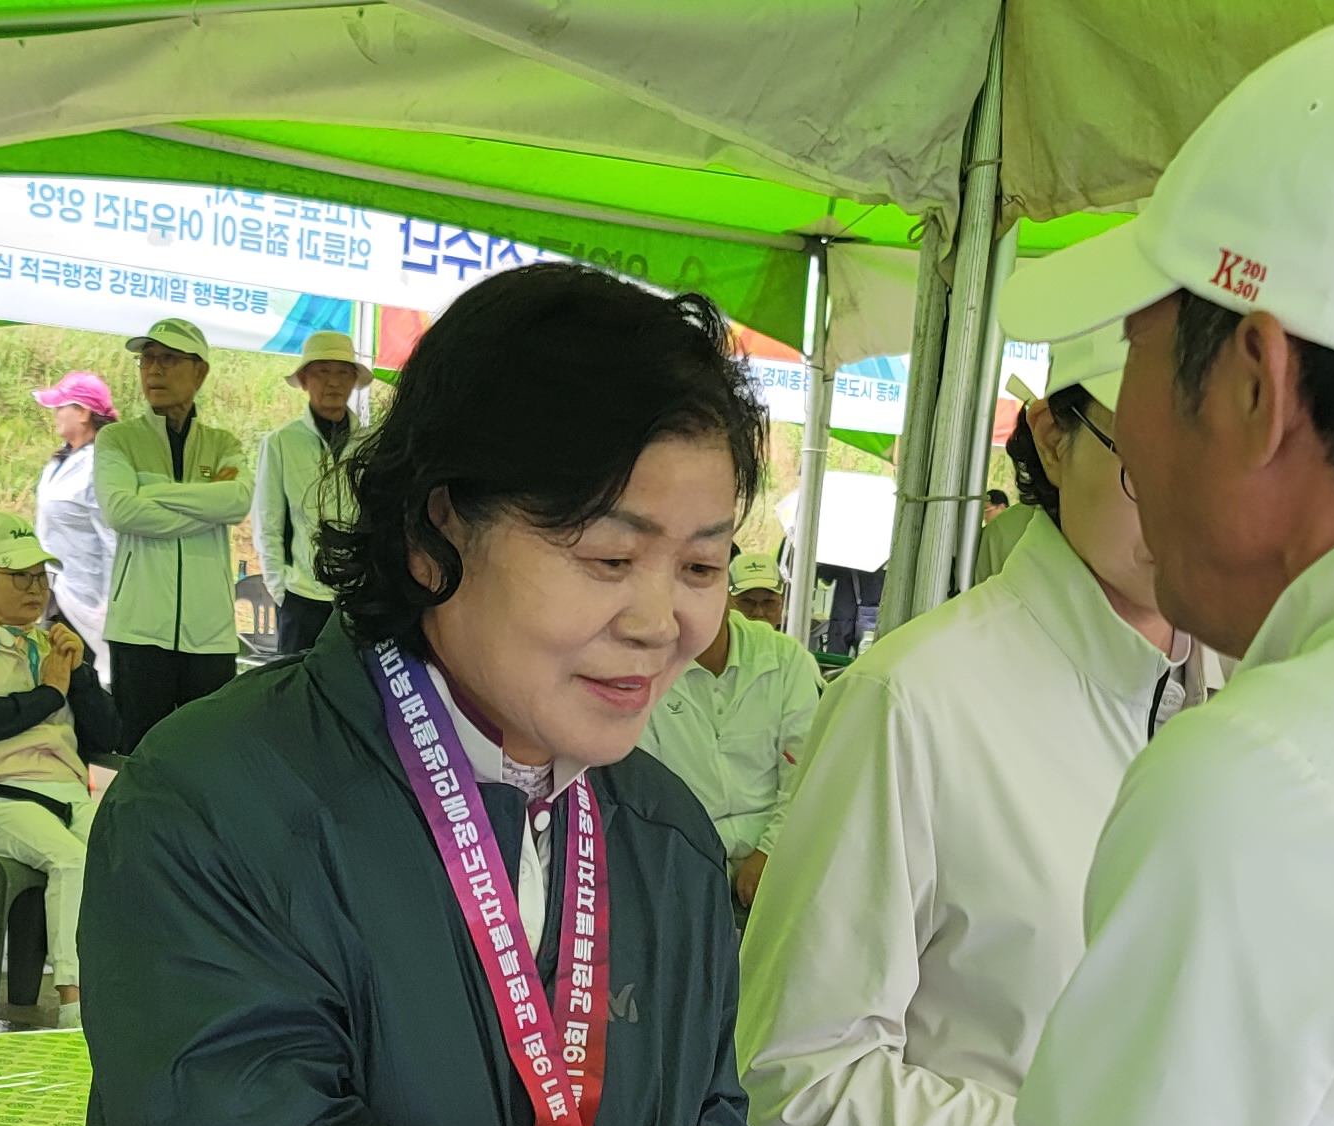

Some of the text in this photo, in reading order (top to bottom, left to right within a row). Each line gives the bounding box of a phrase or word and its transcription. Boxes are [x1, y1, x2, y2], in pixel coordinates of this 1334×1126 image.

[19, 256, 103, 291] 적극행정
[109, 269, 188, 302] 강원제일
[192, 281, 269, 314] 행복강릉
